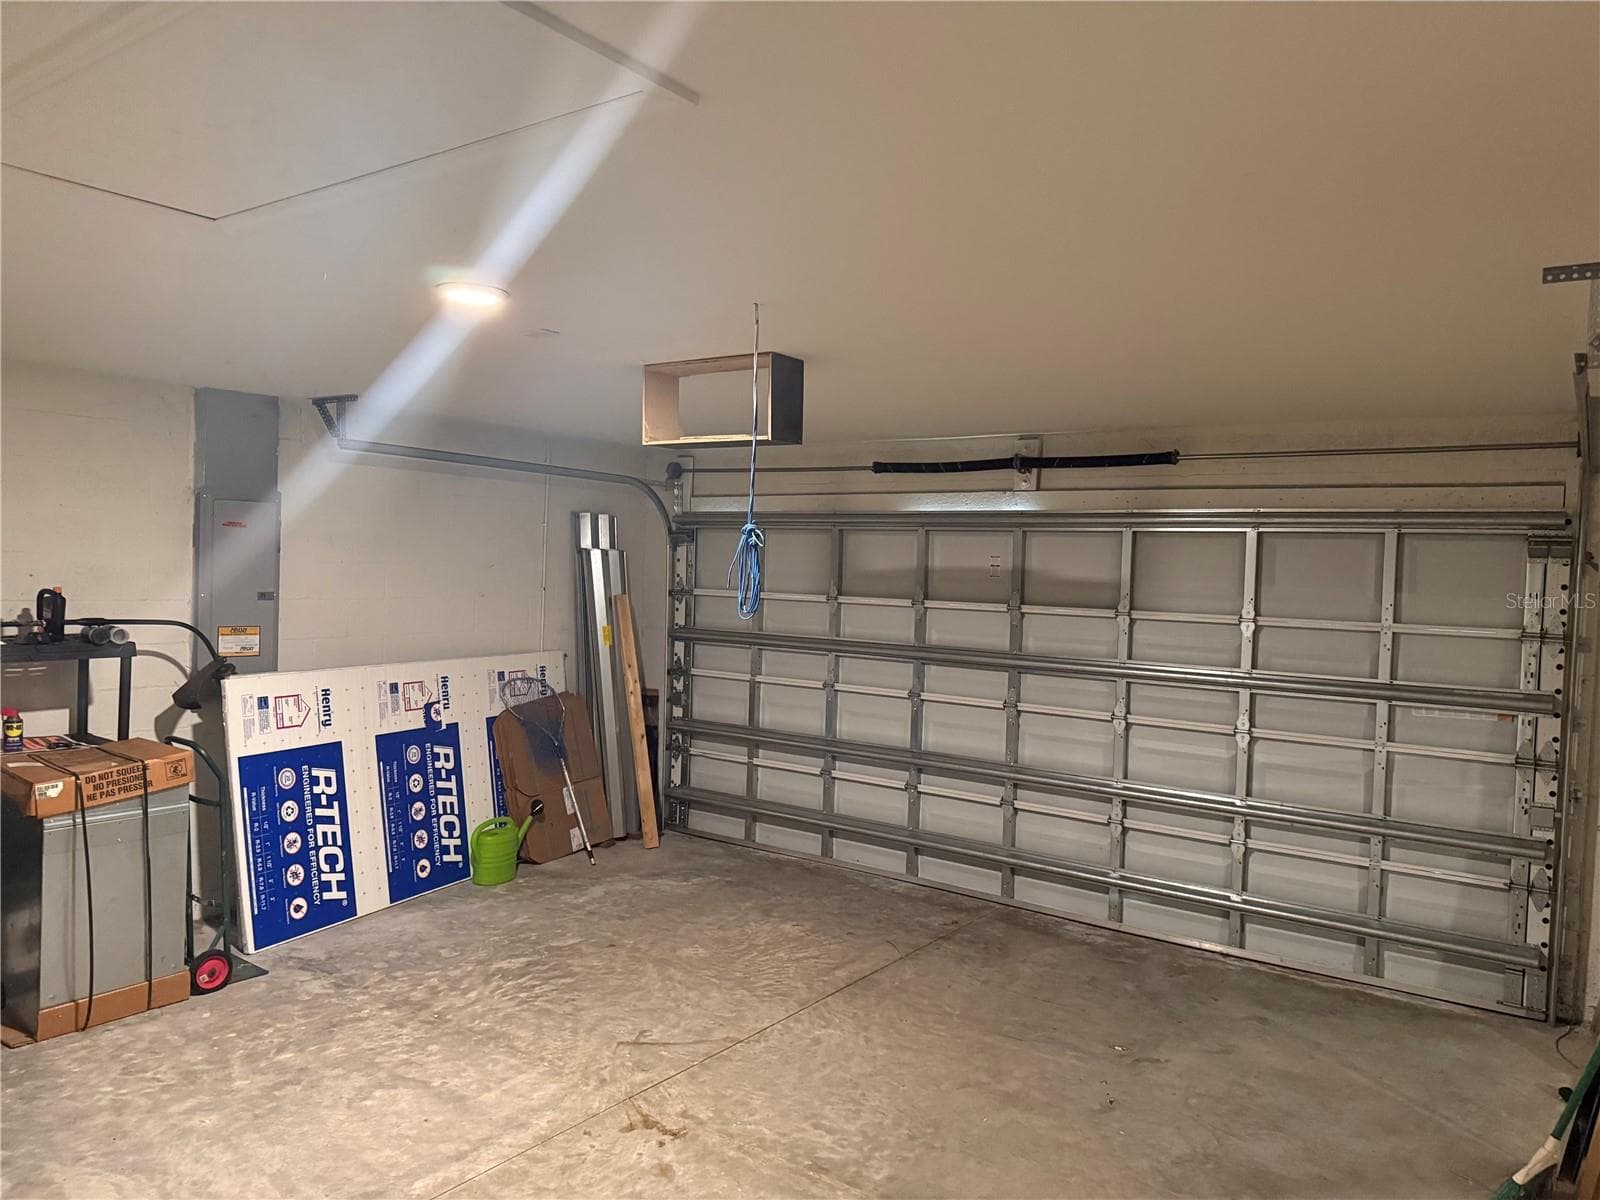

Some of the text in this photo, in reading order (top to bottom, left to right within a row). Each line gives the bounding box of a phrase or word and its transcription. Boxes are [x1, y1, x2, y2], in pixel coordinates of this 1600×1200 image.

[320, 688, 332, 727] Henry
[84, 763, 151, 785] DO NOT SQUEEE
[92, 782, 105, 792] NO
[86, 780, 154, 802] NE PAS PRESSR
[425, 743, 435, 797] ENGINEERED
[431, 818, 442, 866] EFFICIENCY
[301, 765, 321, 905] ENGINEERED FOR EFFICIENCY
